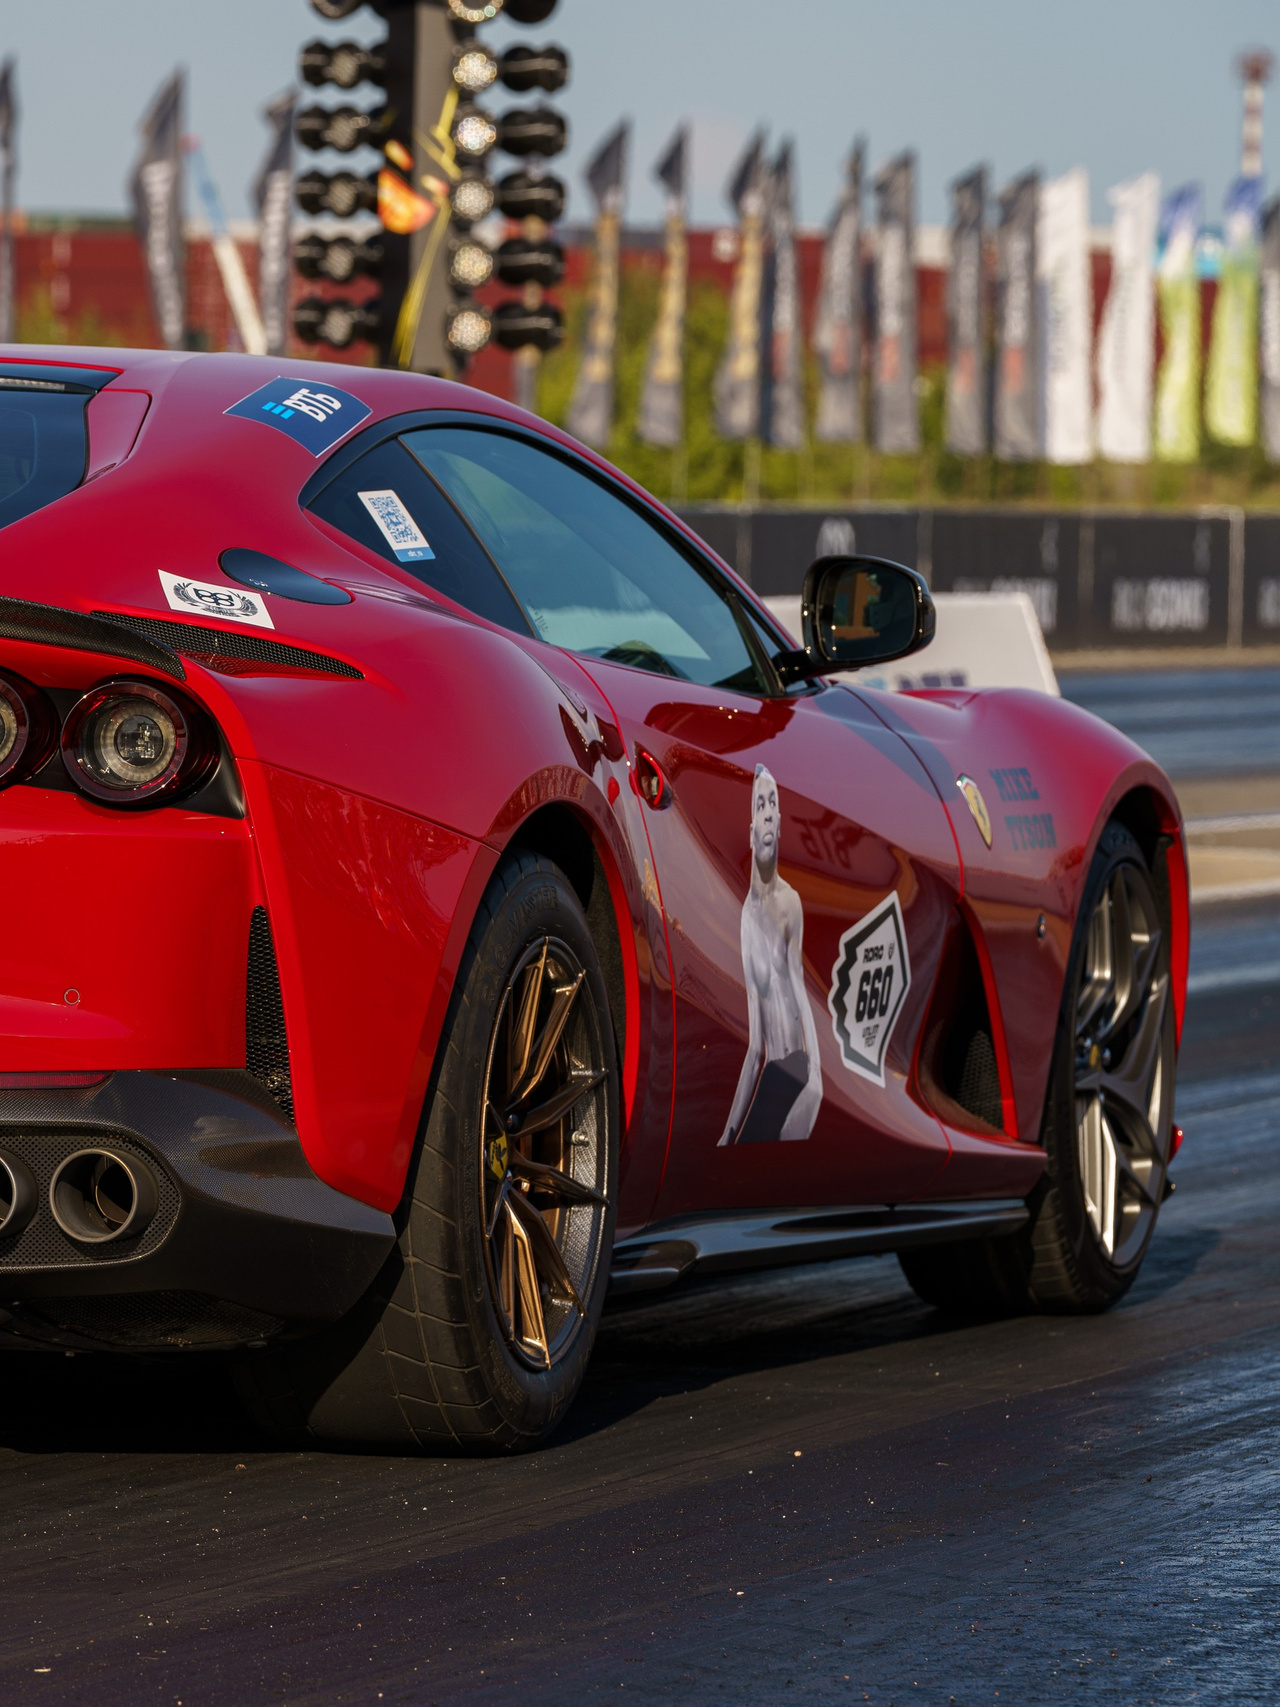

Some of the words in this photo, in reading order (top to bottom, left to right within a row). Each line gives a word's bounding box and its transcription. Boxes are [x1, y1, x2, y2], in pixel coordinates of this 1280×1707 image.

[989, 768, 1040, 801] MIKE
[1004, 813, 1057, 850] TYSON
[855, 964, 894, 1023] 660
